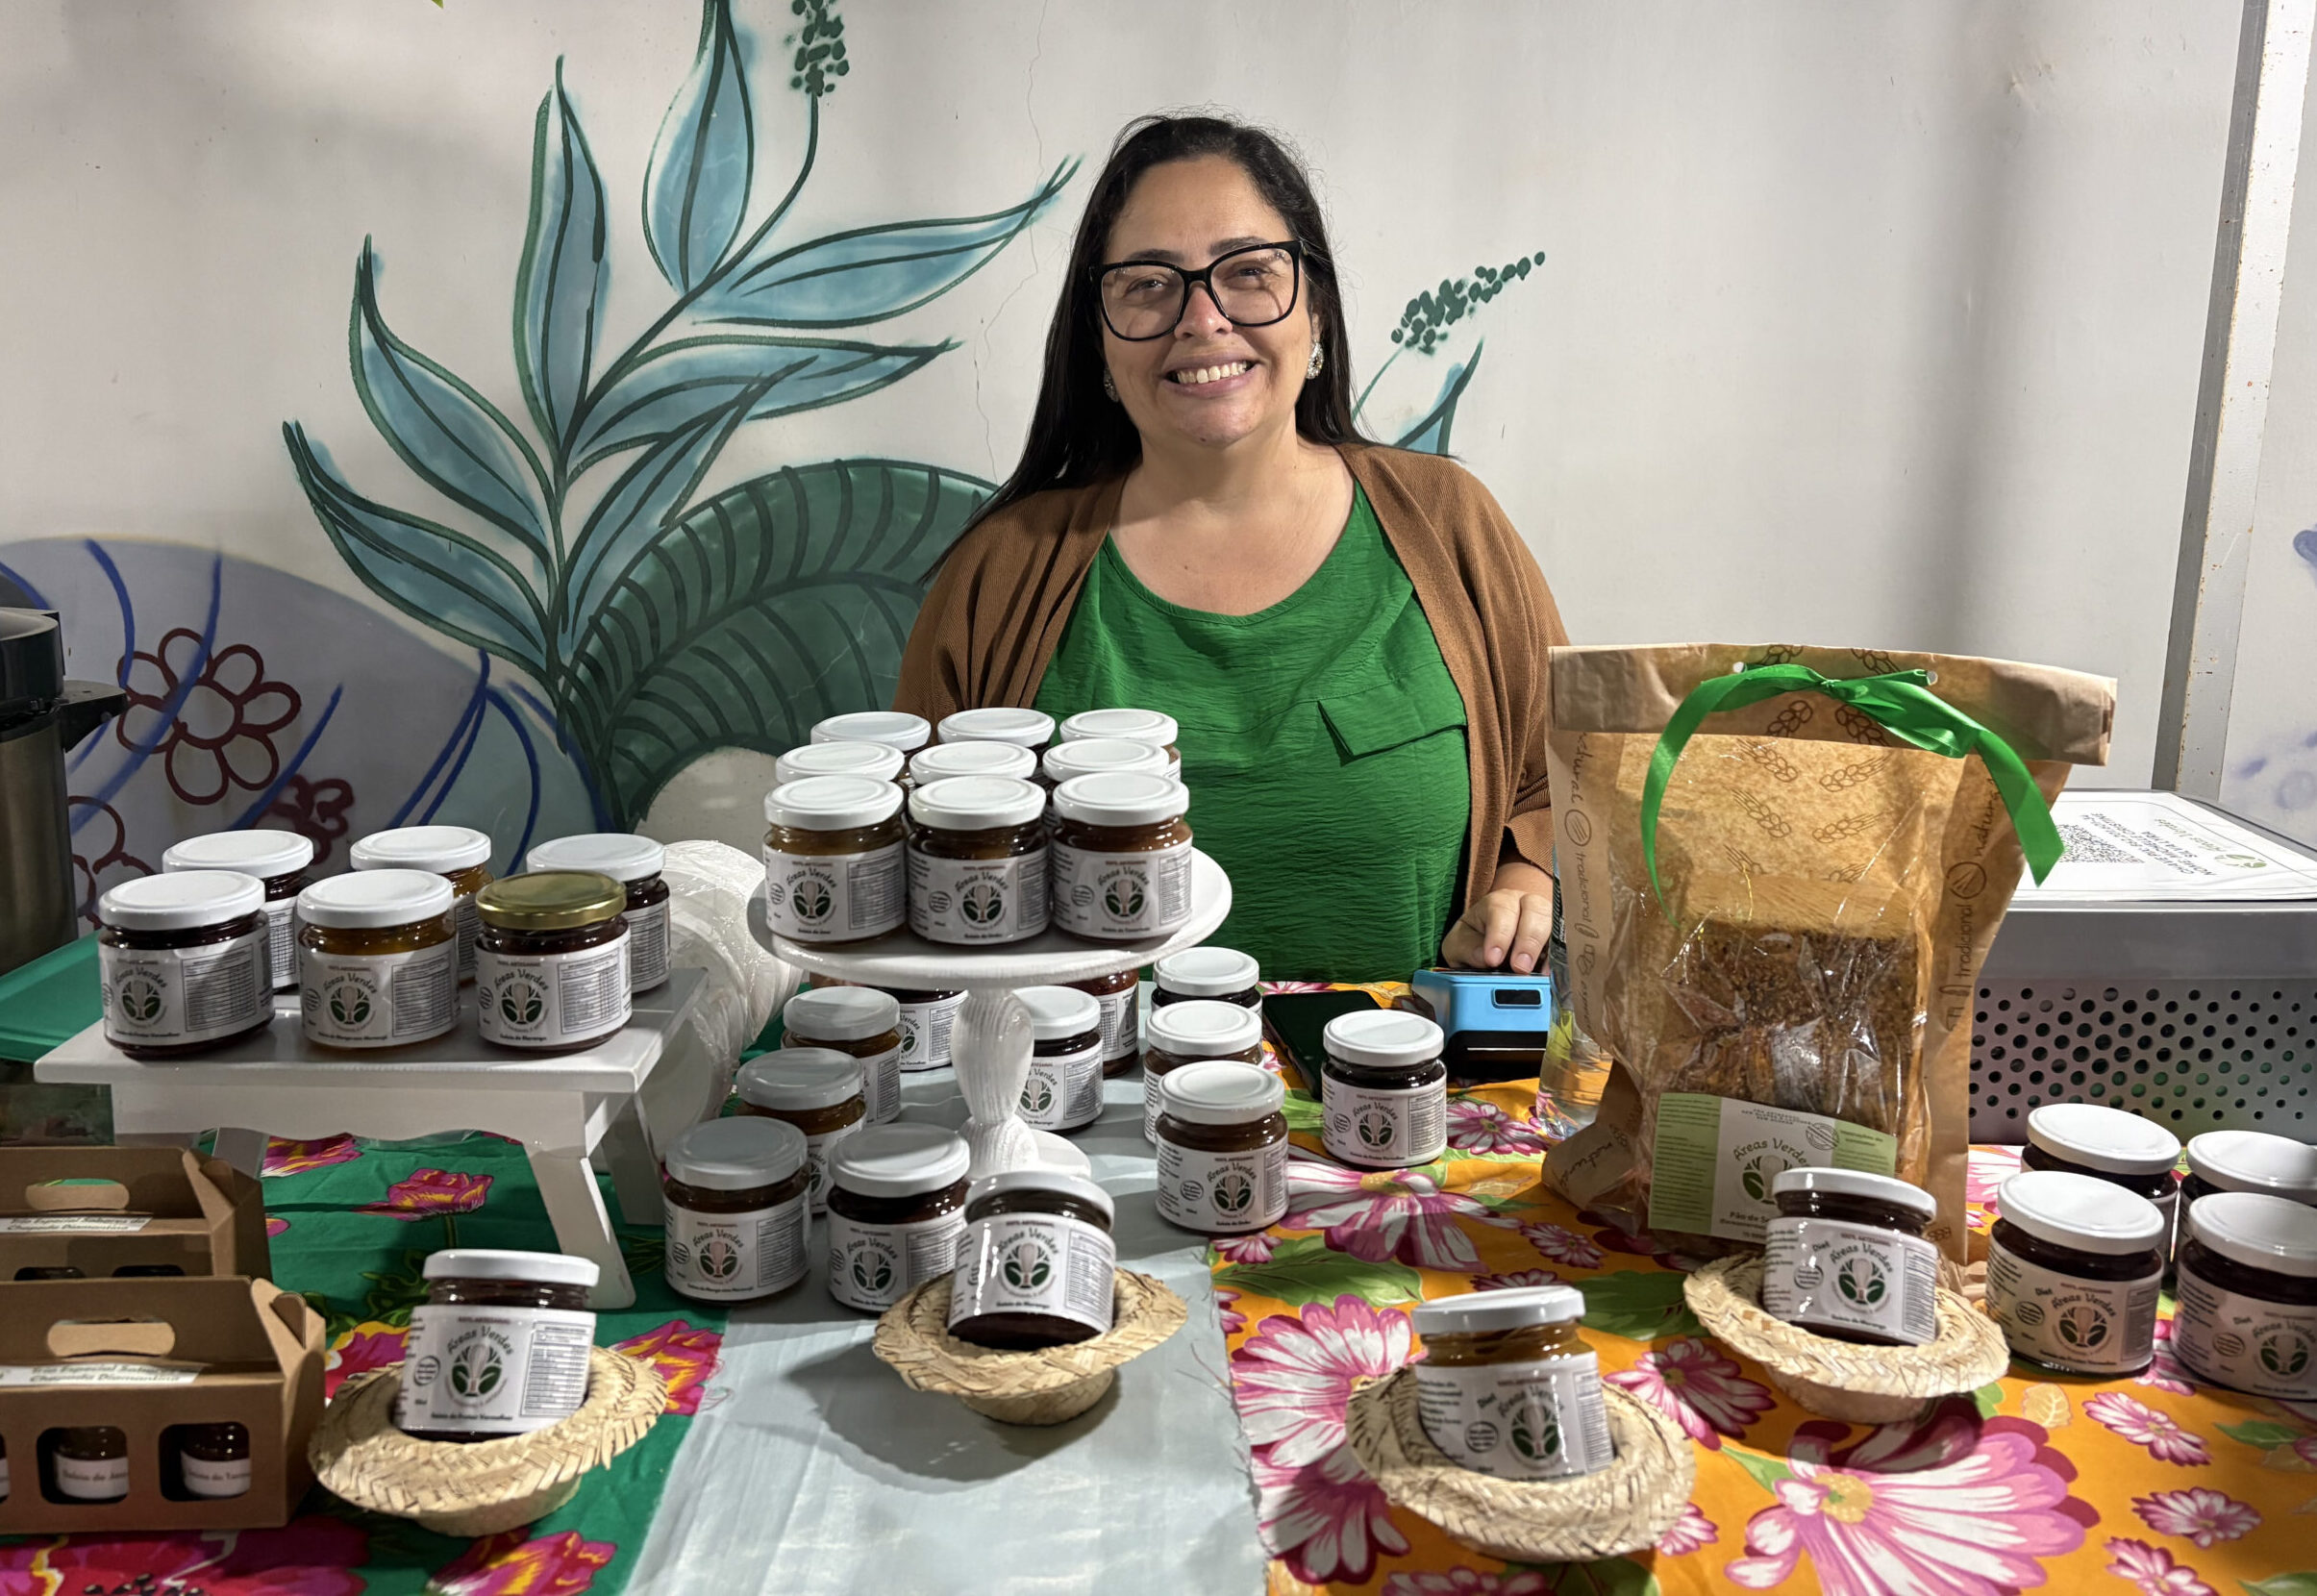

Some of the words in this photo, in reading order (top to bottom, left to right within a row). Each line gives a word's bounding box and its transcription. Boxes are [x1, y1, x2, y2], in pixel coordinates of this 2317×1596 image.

[1955, 904, 1974, 978] tradicional
[1733, 1138, 1768, 1161] Áreas
[1830, 1243, 1859, 1264] Áreas
[1862, 1242, 1893, 1273] Verdes
[2085, 1292, 2116, 1317] Verdes
[481, 1325, 514, 1356] Verdes
